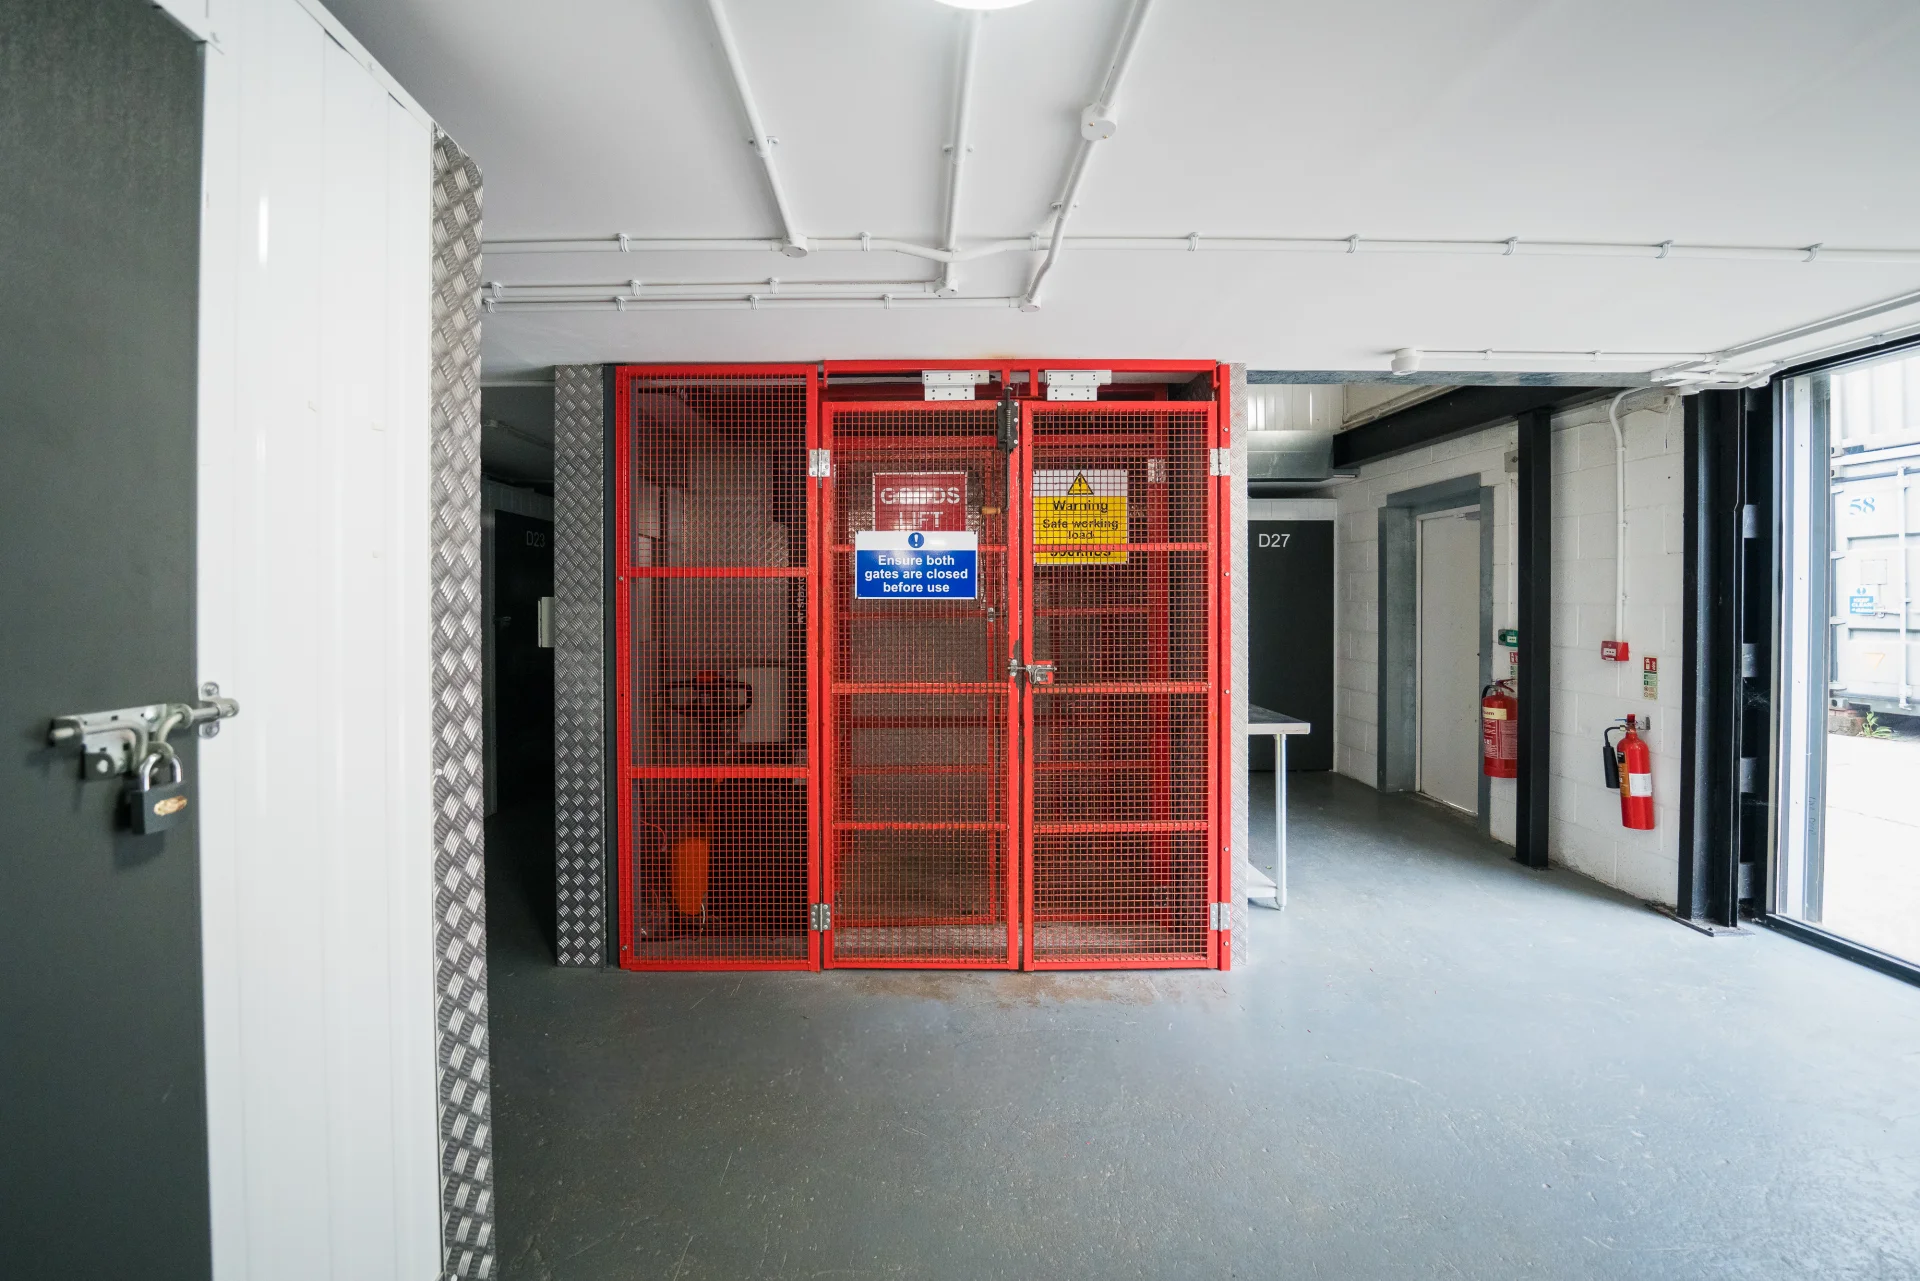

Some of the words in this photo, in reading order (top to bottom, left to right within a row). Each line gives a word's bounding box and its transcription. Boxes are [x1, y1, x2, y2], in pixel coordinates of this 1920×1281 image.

[880, 487, 960, 505] GOODS
[1053, 500, 1108, 513] Warning
[1849, 496, 1876, 515] 58
[899, 511, 944, 528] LIFT
[1042, 518, 1068, 529] Safe
[1072, 518, 1119, 530] working
[526, 530, 546, 548] D23
[1068, 530, 1093, 540] load
[1258, 533, 1291, 548] D27
[878, 555, 923, 566] Ensure
[926, 555, 955, 566] both
[864, 569, 899, 582] gates
[902, 571, 923, 579] are
[926, 568, 968, 579] closed
[883, 582, 924, 593] before
[927, 584, 950, 593] use
